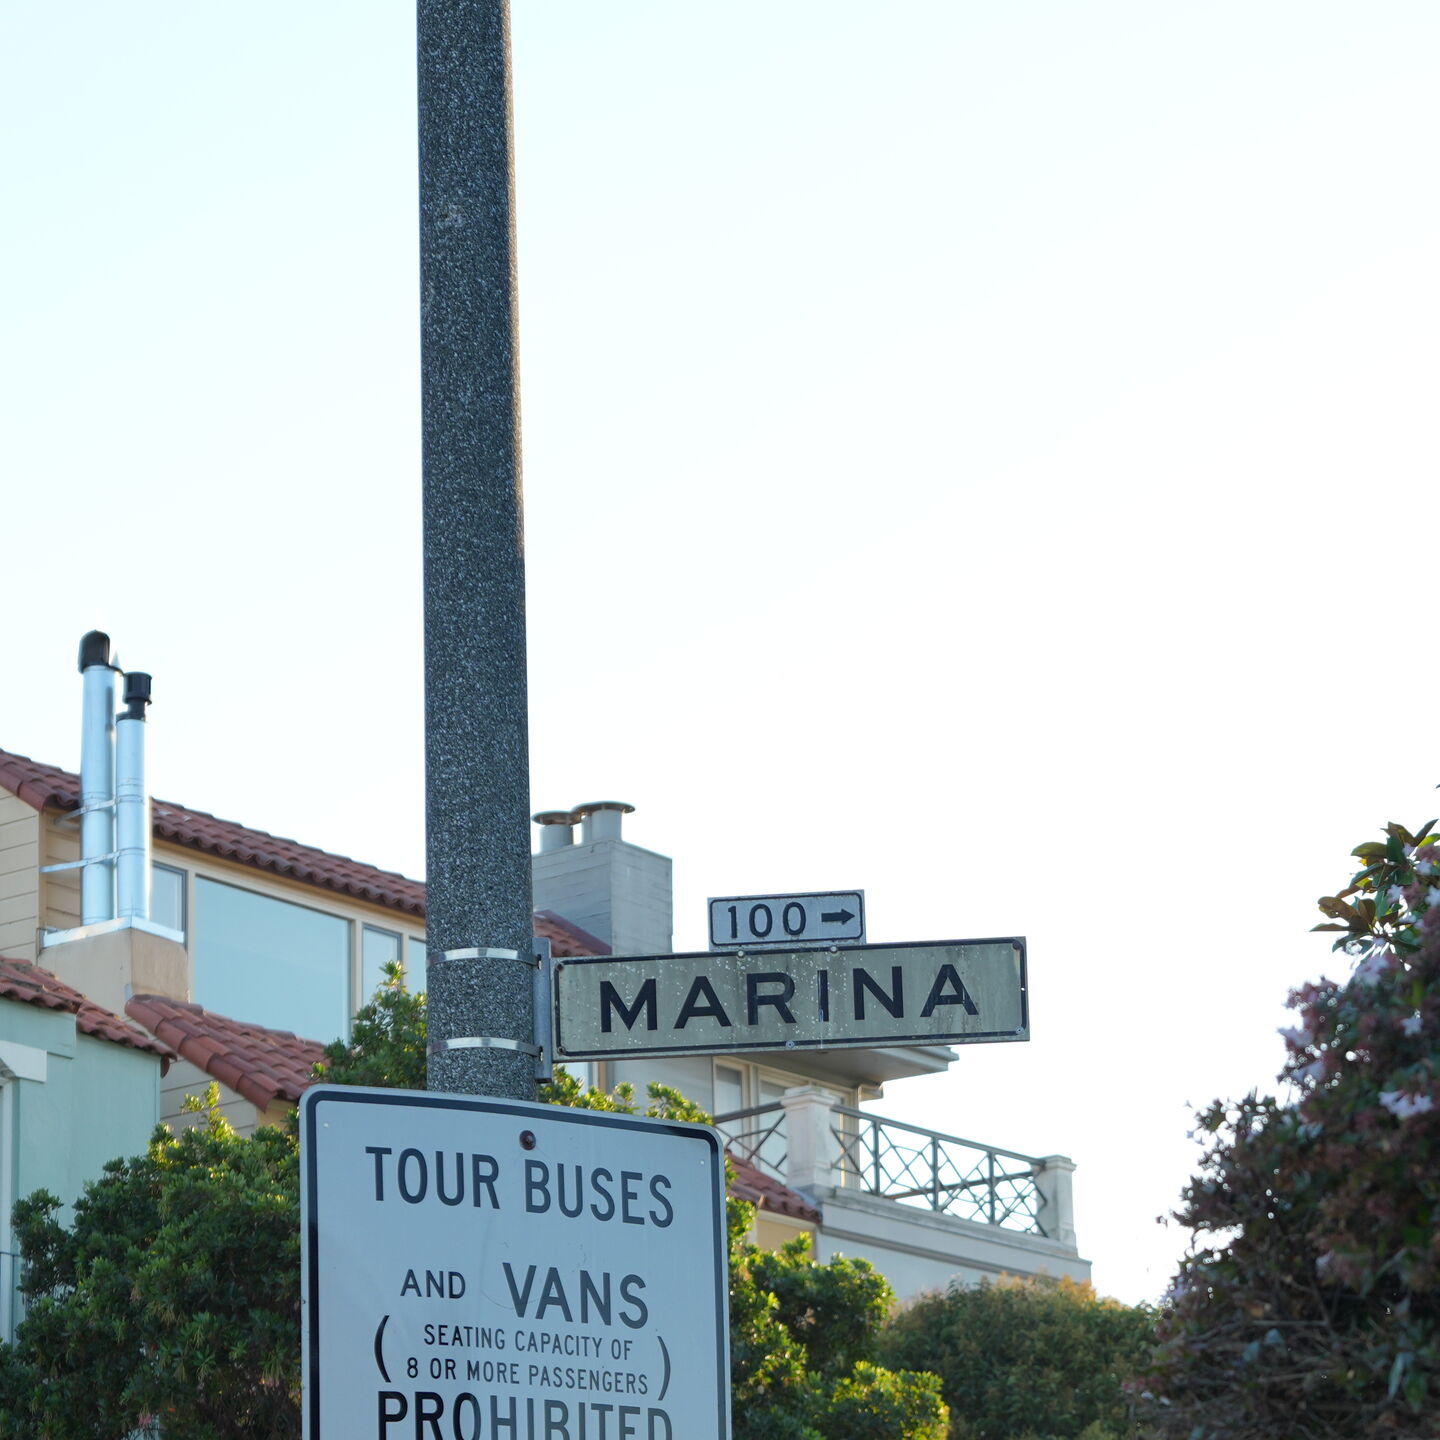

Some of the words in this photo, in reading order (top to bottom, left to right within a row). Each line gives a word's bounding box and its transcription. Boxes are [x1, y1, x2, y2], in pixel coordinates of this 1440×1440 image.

[727, 901, 807, 939] 100
[599, 963, 980, 1034] MARINA
[364, 1146, 501, 1210] TOUR
[524, 1158, 674, 1229] BUSES
[400, 1268, 466, 1300] AND
[502, 1261, 649, 1330] VANS
[423, 1323, 506, 1351] SEATING
[514, 1329, 603, 1358] CAPACITY
[610, 1338, 633, 1361] OF
[406, 1357, 419, 1379] 8
[429, 1357, 457, 1380] OR
[466, 1359, 520, 1385] MORE
[528, 1364, 649, 1395] PASSENGERS
